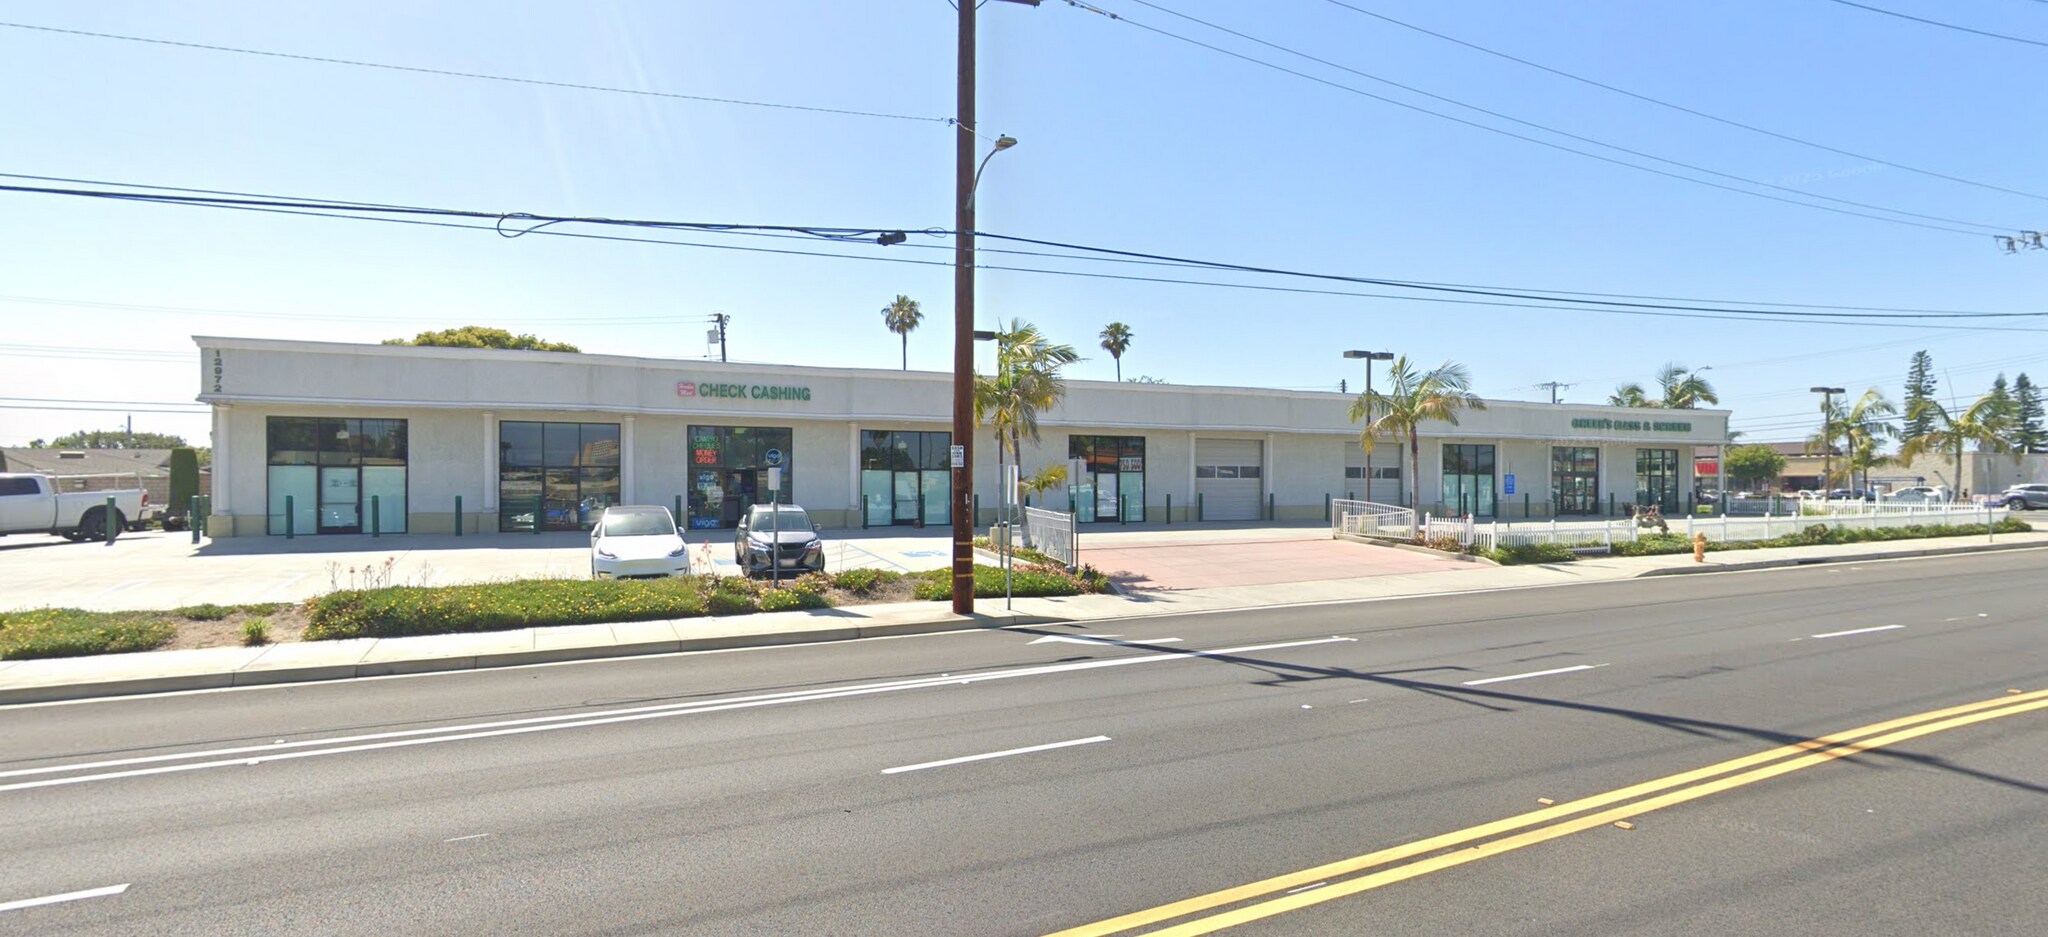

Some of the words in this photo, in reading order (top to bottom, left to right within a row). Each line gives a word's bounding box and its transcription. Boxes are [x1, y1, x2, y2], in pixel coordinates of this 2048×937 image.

[213, 349, 223, 393] 12972
[699, 382, 747, 399] CHECK
[751, 385, 811, 401] CASHING
[696, 456, 717, 464] ORDER
